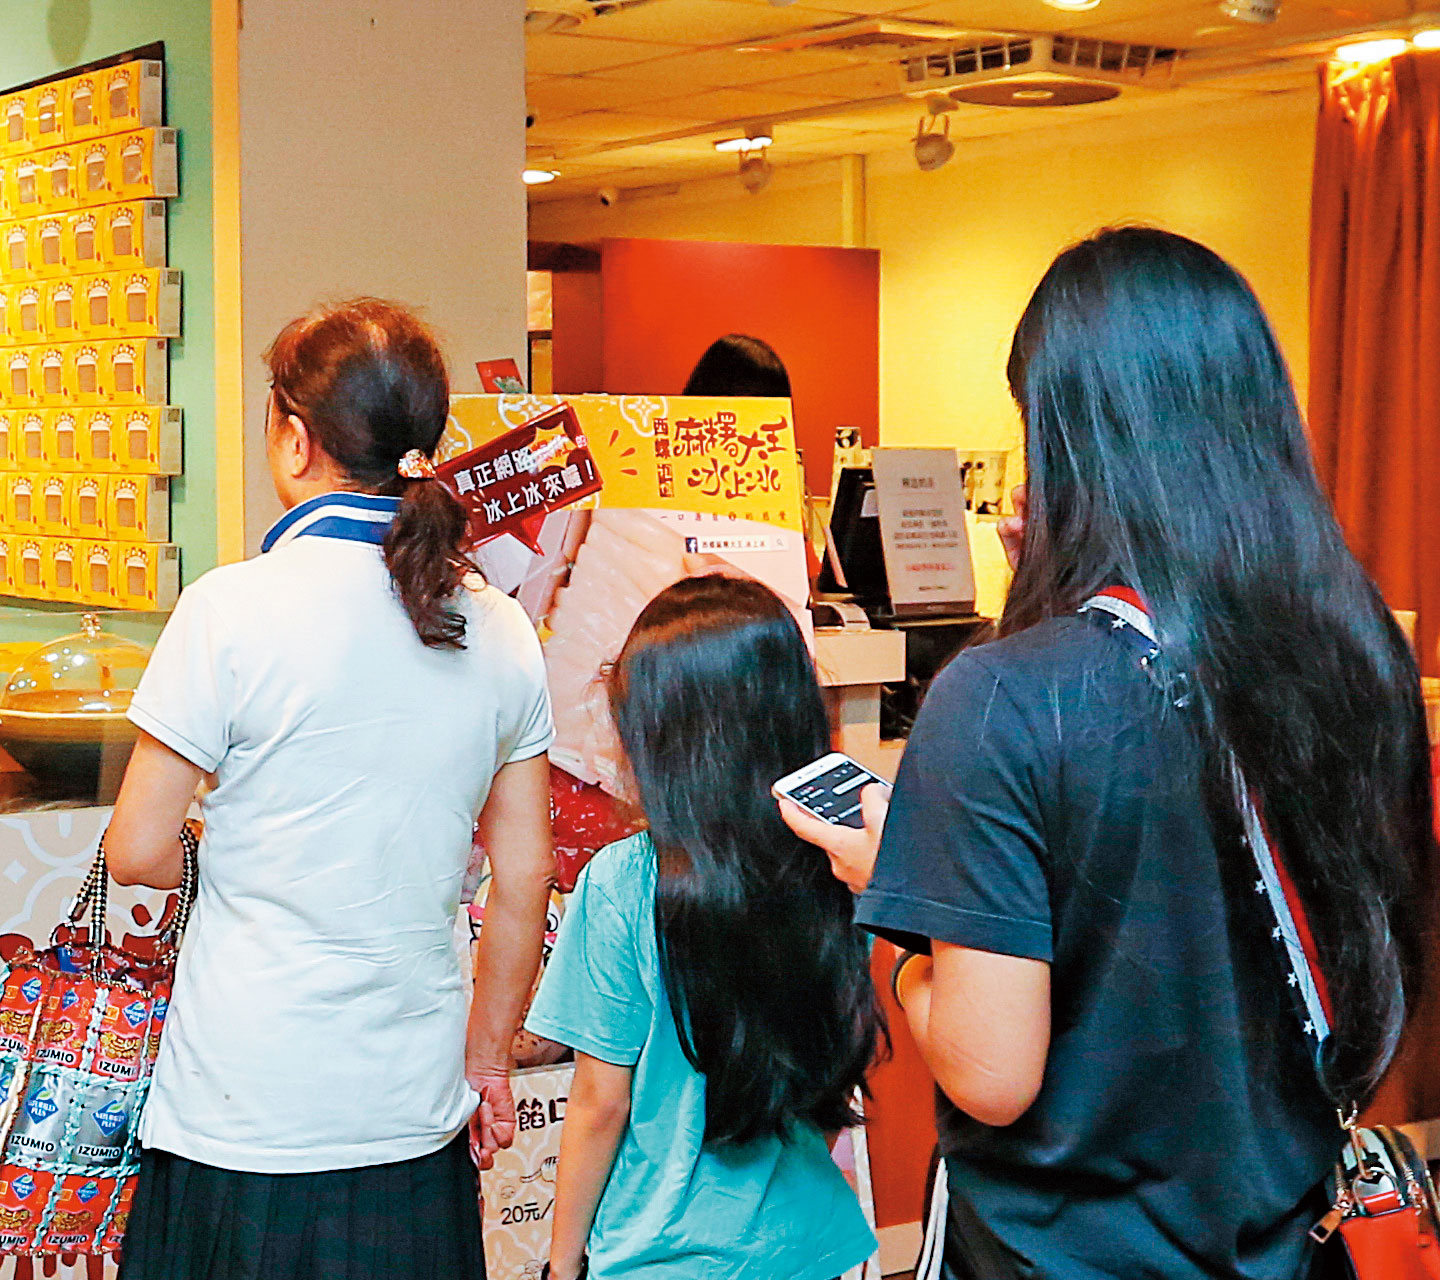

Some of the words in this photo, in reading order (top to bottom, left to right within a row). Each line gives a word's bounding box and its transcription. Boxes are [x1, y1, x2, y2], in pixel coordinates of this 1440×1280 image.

[673, 411, 789, 466] 麻糬大王
[687, 458, 781, 499] 冰上冰
[10, 1135, 55, 1152] IZUMIO
[77, 1145, 120, 1158] IZUMIO
